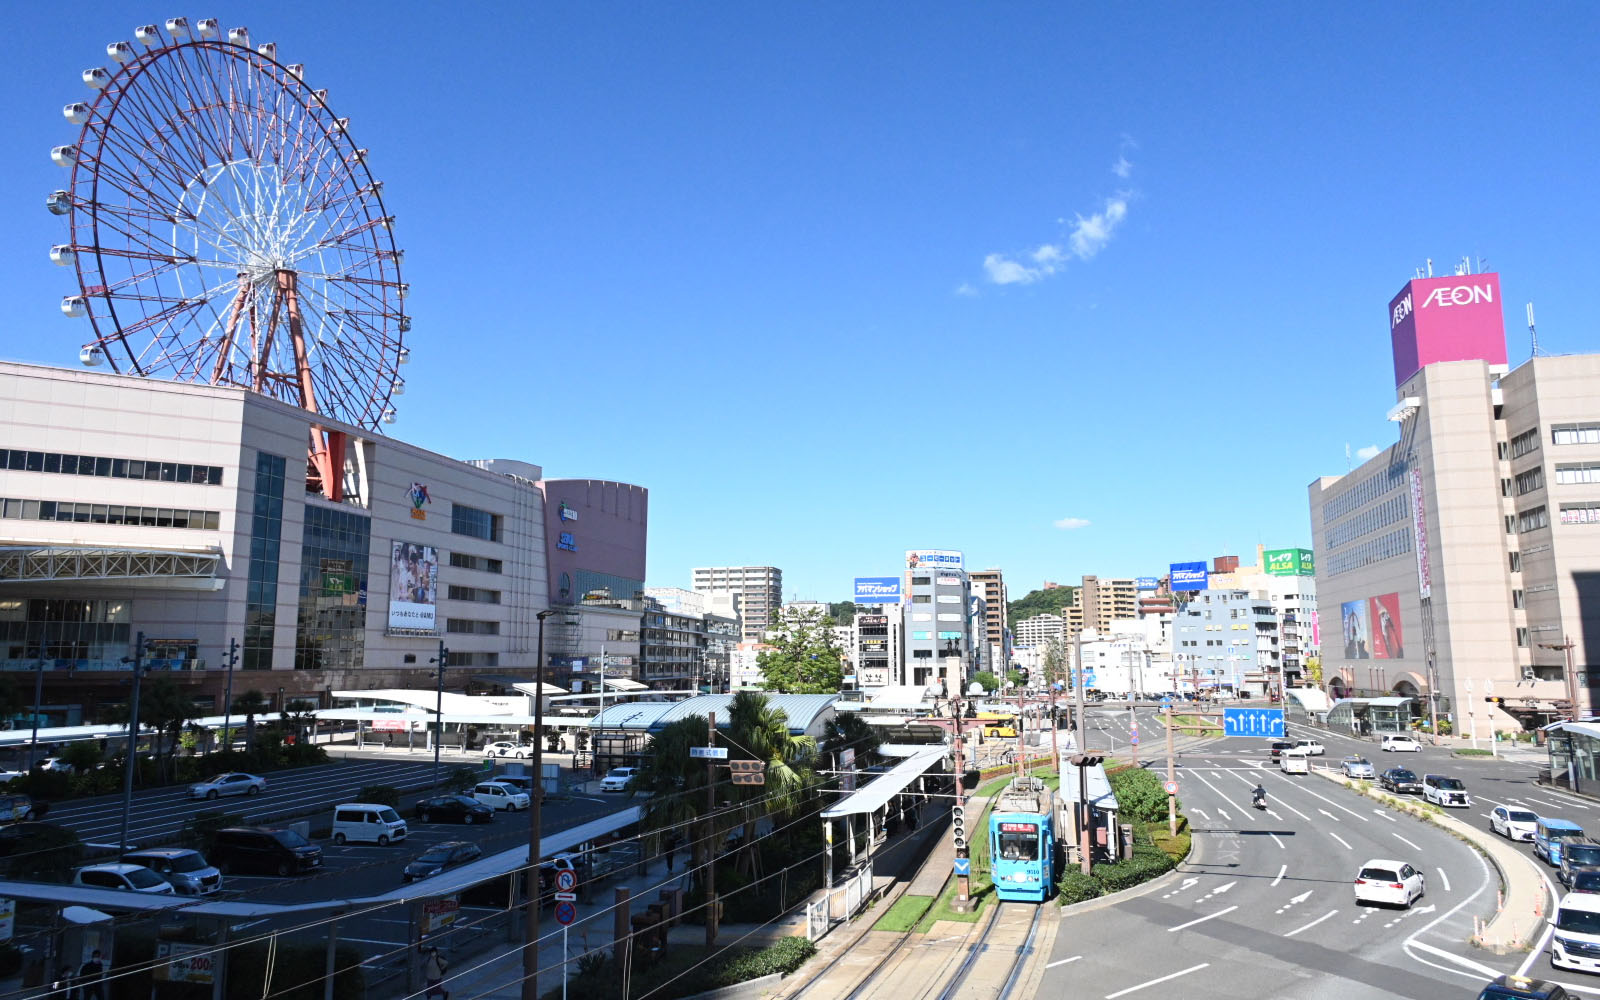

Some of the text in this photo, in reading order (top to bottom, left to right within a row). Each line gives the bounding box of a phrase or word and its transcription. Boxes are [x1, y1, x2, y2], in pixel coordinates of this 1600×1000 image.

[1269, 552, 1292, 562] レイク
[1300, 552, 1311, 562] レイク
[1269, 561, 1293, 570] ALSA
[856, 584, 898, 593] アパマンショップ
